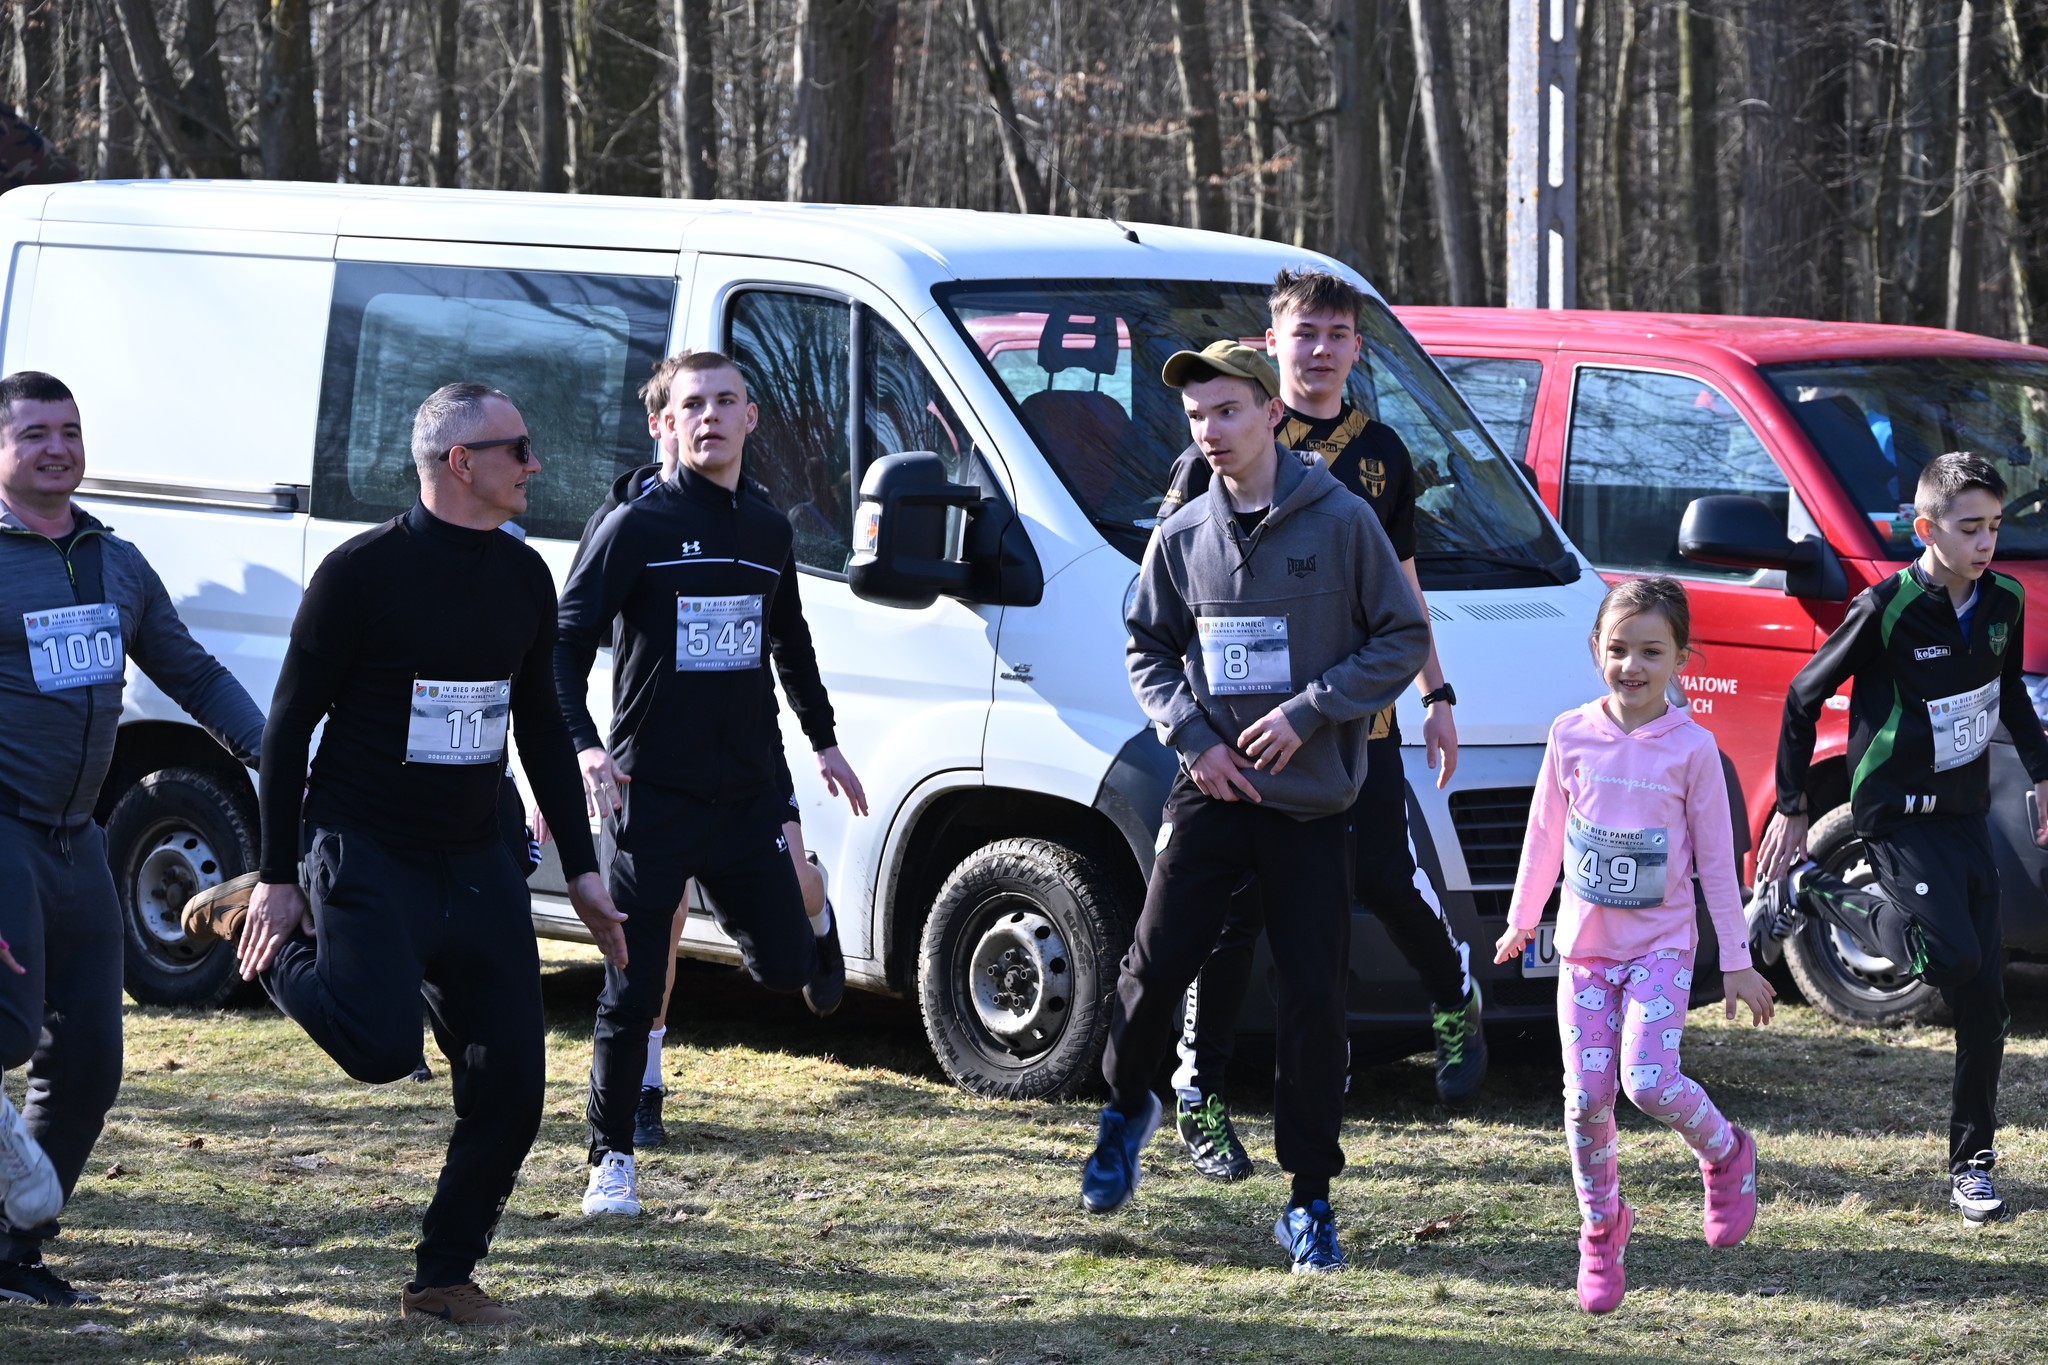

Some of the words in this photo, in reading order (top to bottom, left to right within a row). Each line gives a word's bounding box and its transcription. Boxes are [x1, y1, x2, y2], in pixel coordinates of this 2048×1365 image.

[1287, 554, 1316, 575] EVERLAST
[42, 630, 115, 674] 100
[687, 621, 757, 657] 542
[1224, 643, 1249, 680] 8
[1687, 698, 1713, 714] CH
[447, 709, 483, 748] 11
[1953, 709, 1988, 753] 50
[1591, 827, 1607, 837] BIEG
[1578, 848, 1637, 893] 49
[1524, 952, 1534, 962] PL
[1540, 929, 1560, 963] U
